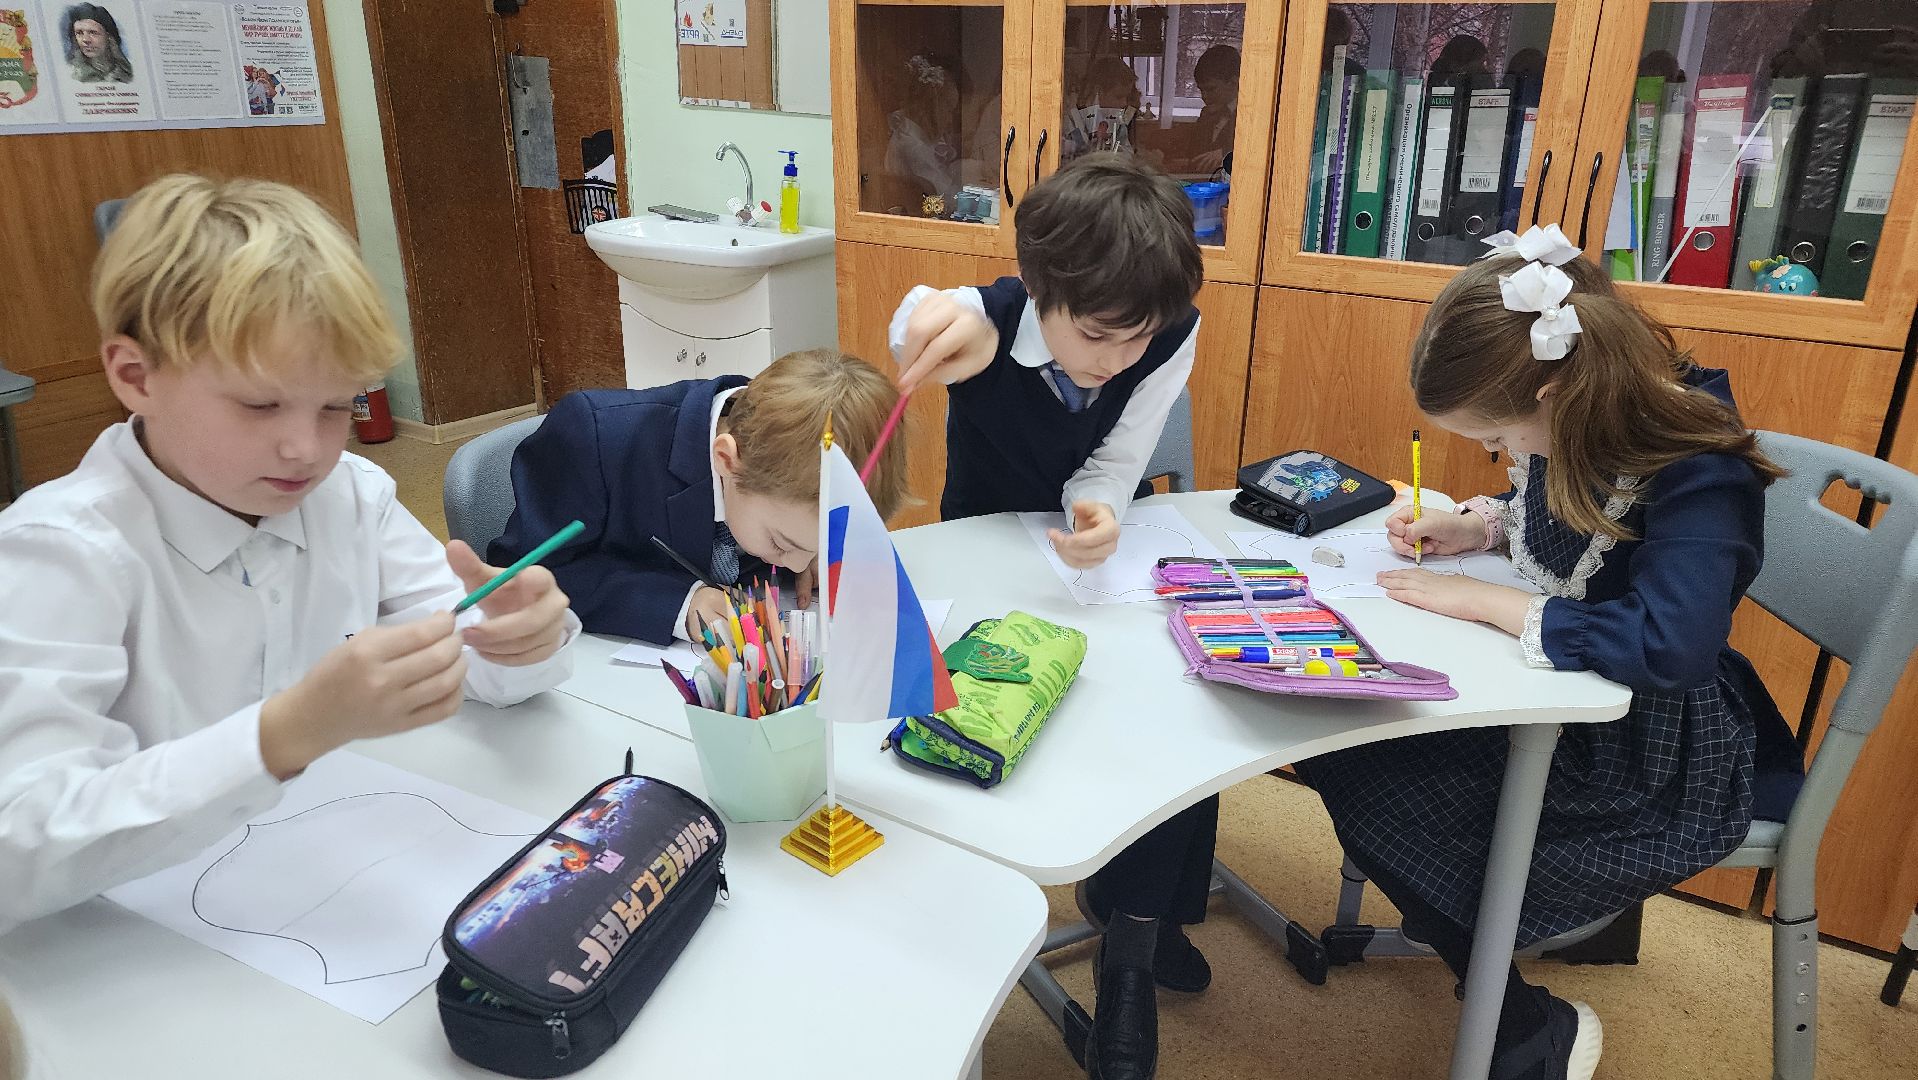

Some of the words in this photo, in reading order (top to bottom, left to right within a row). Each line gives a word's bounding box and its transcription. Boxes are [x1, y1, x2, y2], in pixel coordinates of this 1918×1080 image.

[1401, 103, 1413, 153] Организация
[1654, 212, 1666, 244] BINDER
[1651, 247, 1661, 268] RING
[548, 815, 720, 994] MINECRAFT
